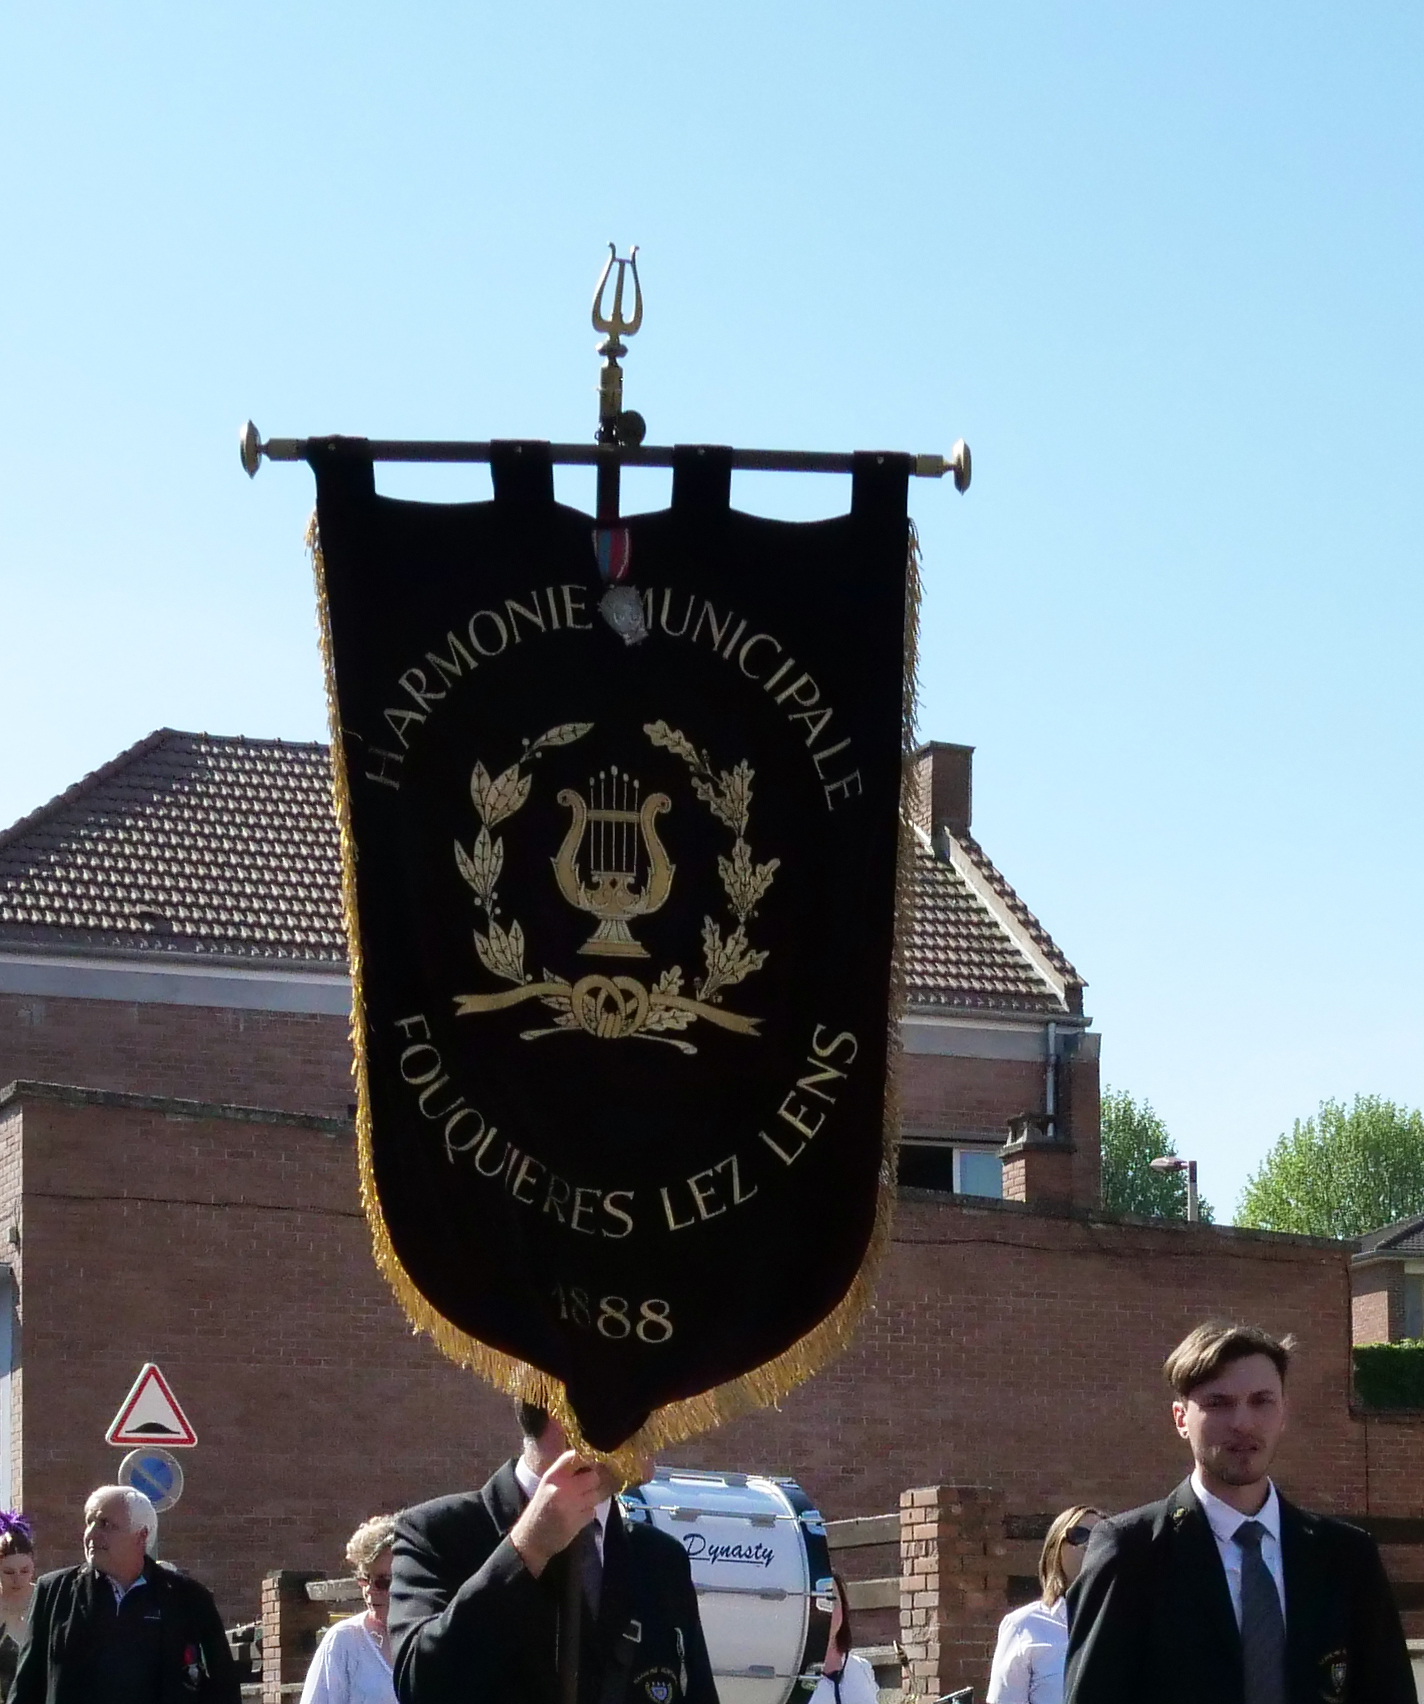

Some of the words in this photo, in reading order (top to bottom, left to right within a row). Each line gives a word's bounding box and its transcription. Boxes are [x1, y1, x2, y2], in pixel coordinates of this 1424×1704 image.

[366, 585, 593, 790] HARMONIE
[394, 1014, 634, 1238] FOUQUIERES
[659, 1154, 758, 1232] LEZ
[757, 1022, 859, 1166] LENS
[551, 1281, 673, 1343] 1888
[682, 1533, 775, 1567] Dynasty
